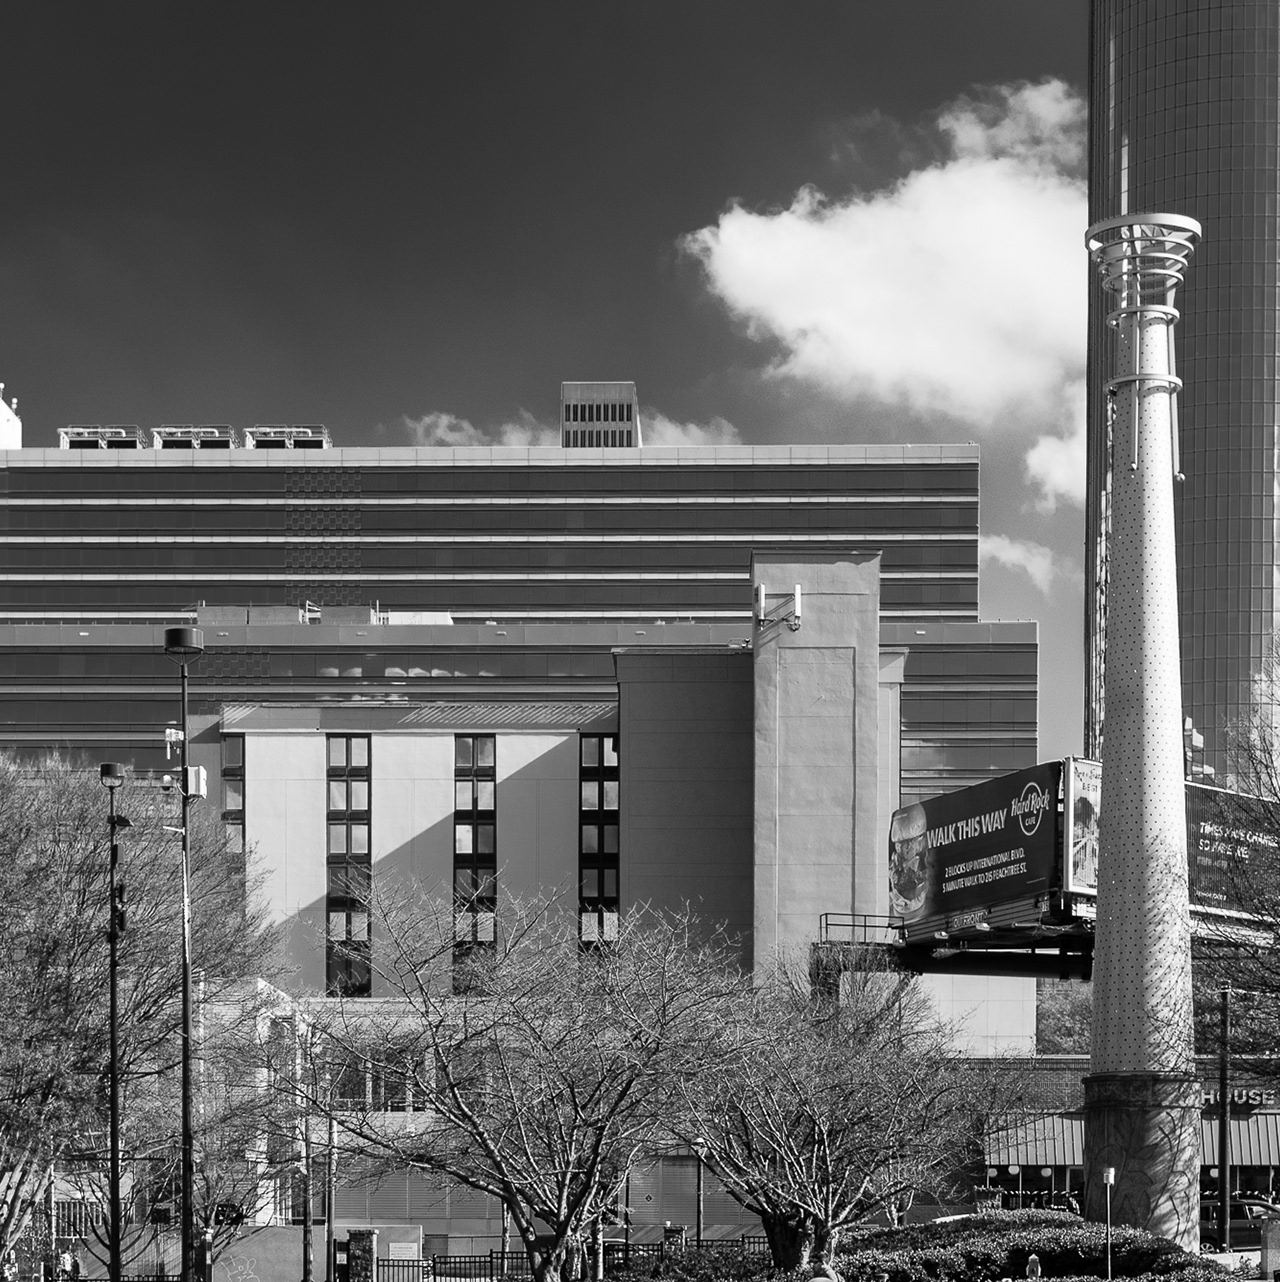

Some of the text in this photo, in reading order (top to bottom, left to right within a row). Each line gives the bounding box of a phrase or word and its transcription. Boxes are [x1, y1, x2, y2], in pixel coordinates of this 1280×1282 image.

[1010, 788, 1050, 817] Hard Rock
[926, 808, 1008, 849] WALK THIS WAY
[946, 878, 964, 892] MINUTE
[963, 875, 979, 887] WALK
[978, 873, 985, 884] TO
[992, 863, 1020, 880] PEACHTREE
[948, 863, 966, 877] BLOCKS
[966, 862, 974, 872] UP
[973, 851, 1011, 869] INTERNATIONAL
